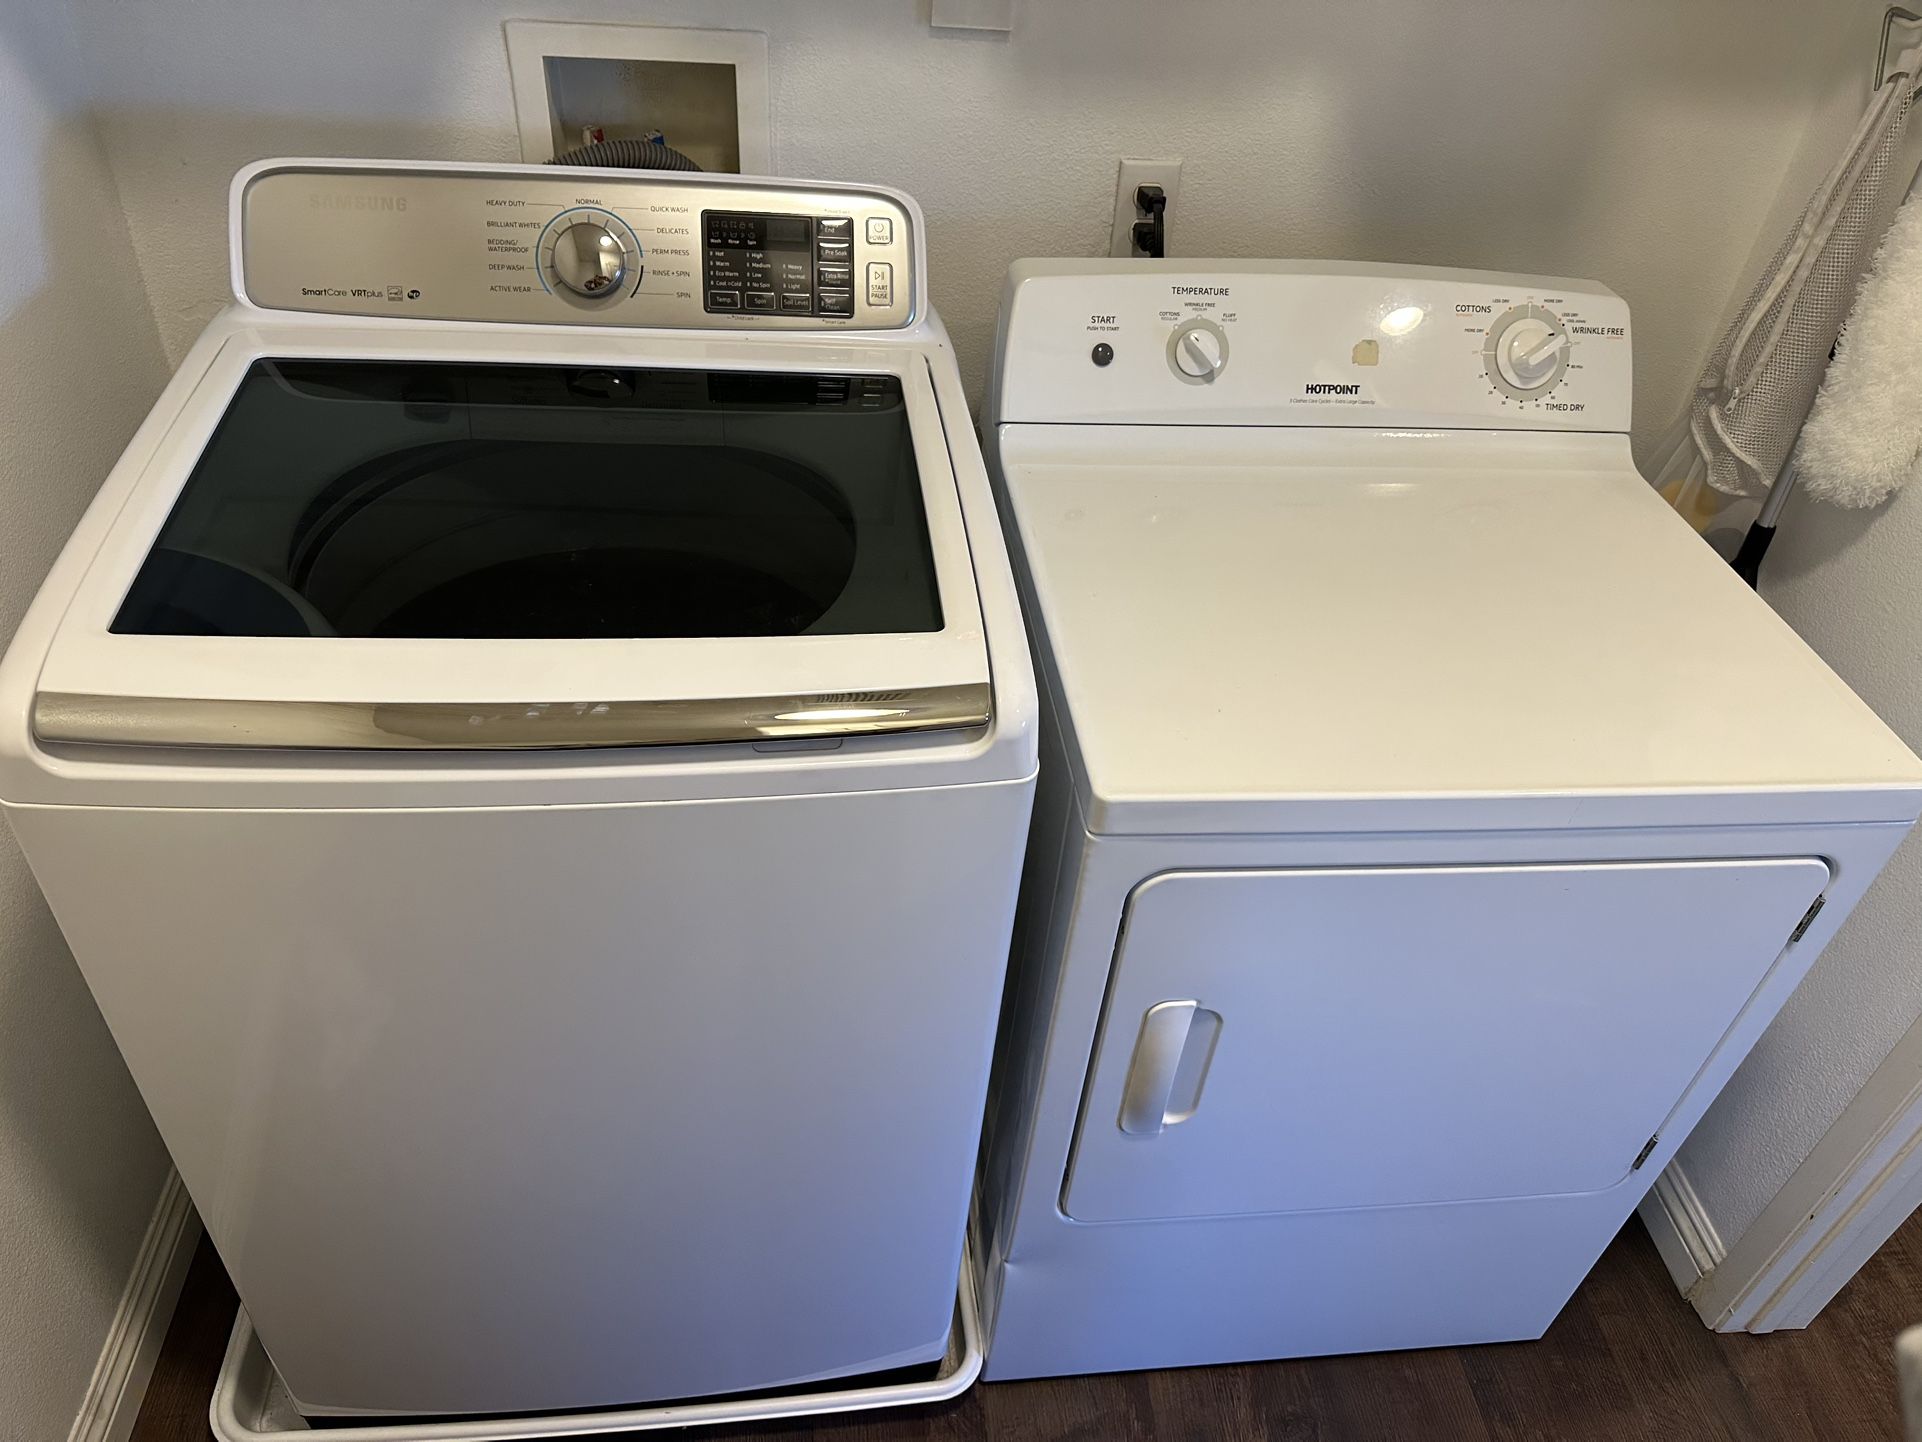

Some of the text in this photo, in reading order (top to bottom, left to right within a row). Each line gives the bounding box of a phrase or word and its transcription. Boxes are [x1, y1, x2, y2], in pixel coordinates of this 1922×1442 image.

[575, 198, 603, 206] NORMAL
[650, 205, 669, 213] QUICK
[656, 227, 689, 235] DELICATES
[302, 287, 348, 297] SmartCare
[350, 289, 384, 299] VRTplus
[489, 285, 514, 293] ACTIVE
[1171, 286, 1230, 296] TEMPERATURE
[1455, 304, 1492, 313] COTTONS
[1090, 315, 1116, 324] START
[1571, 326, 1625, 336] WRINKLE FREE
[1305, 383, 1361, 395] HOTPOINT
[1545, 403, 1585, 412] TIMED DRY
